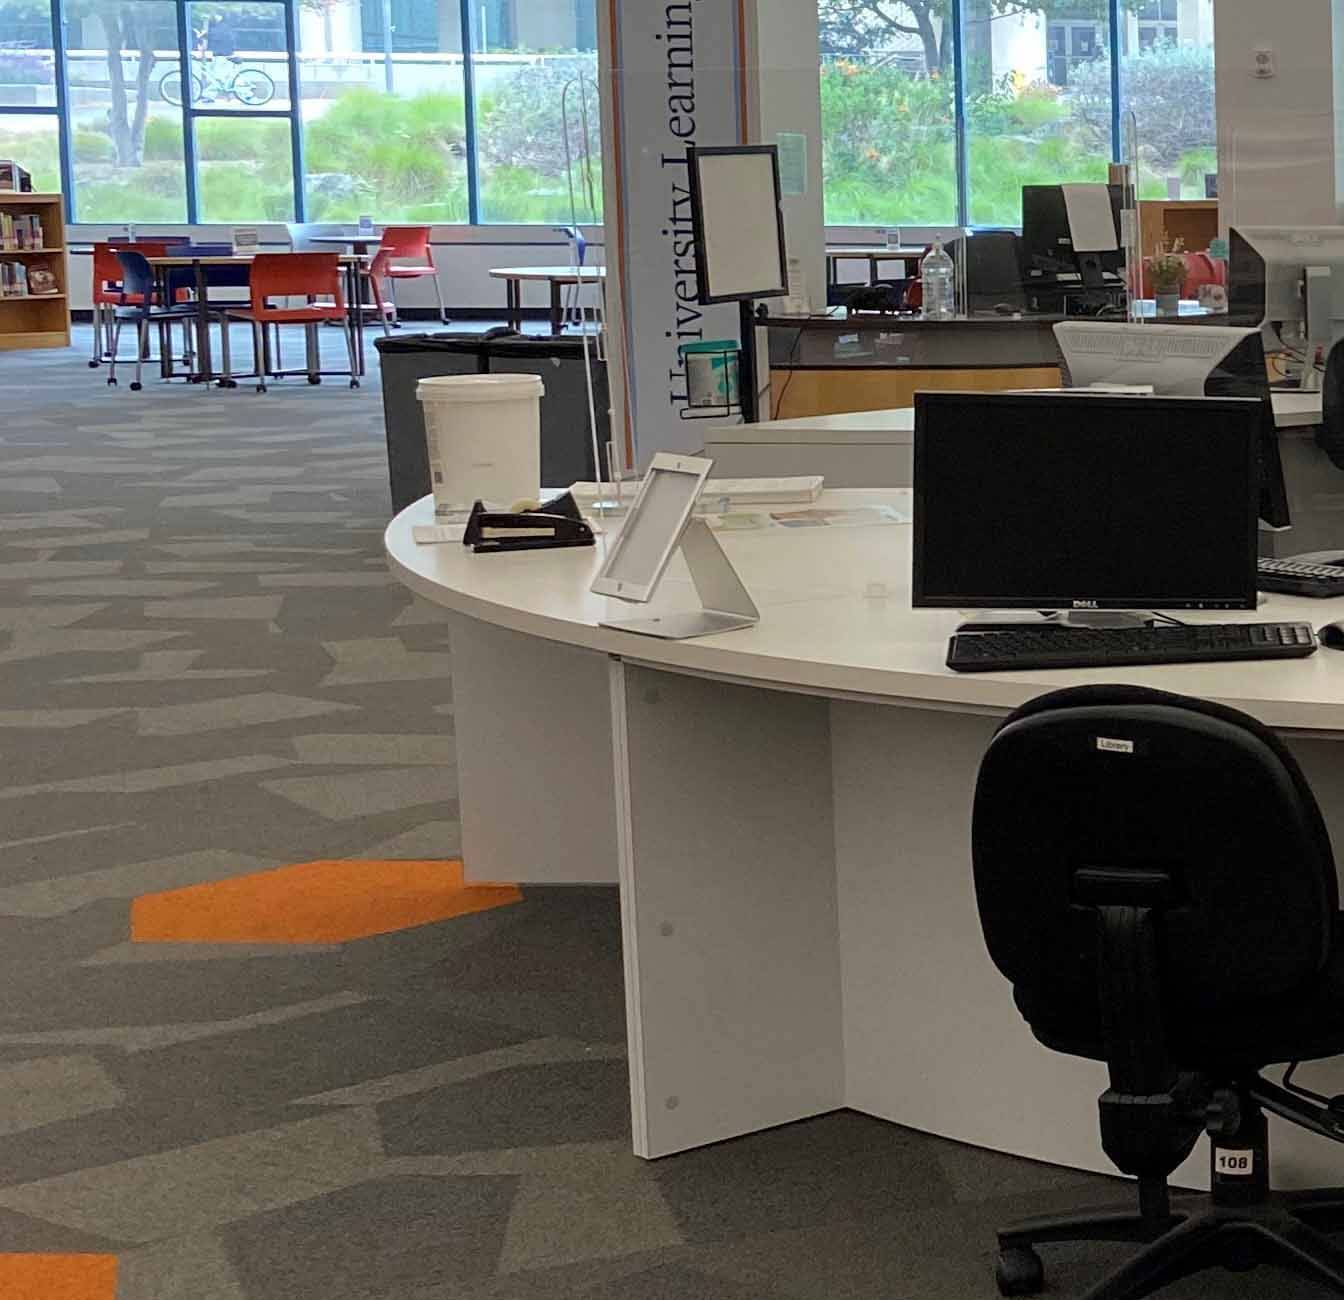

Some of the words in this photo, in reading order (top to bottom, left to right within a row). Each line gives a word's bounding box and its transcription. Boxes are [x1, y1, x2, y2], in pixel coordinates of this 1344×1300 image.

[655, 0, 698, 168] Learnin
[1072, 599, 1099, 609] DELL
[1219, 1156, 1248, 1169] 108
